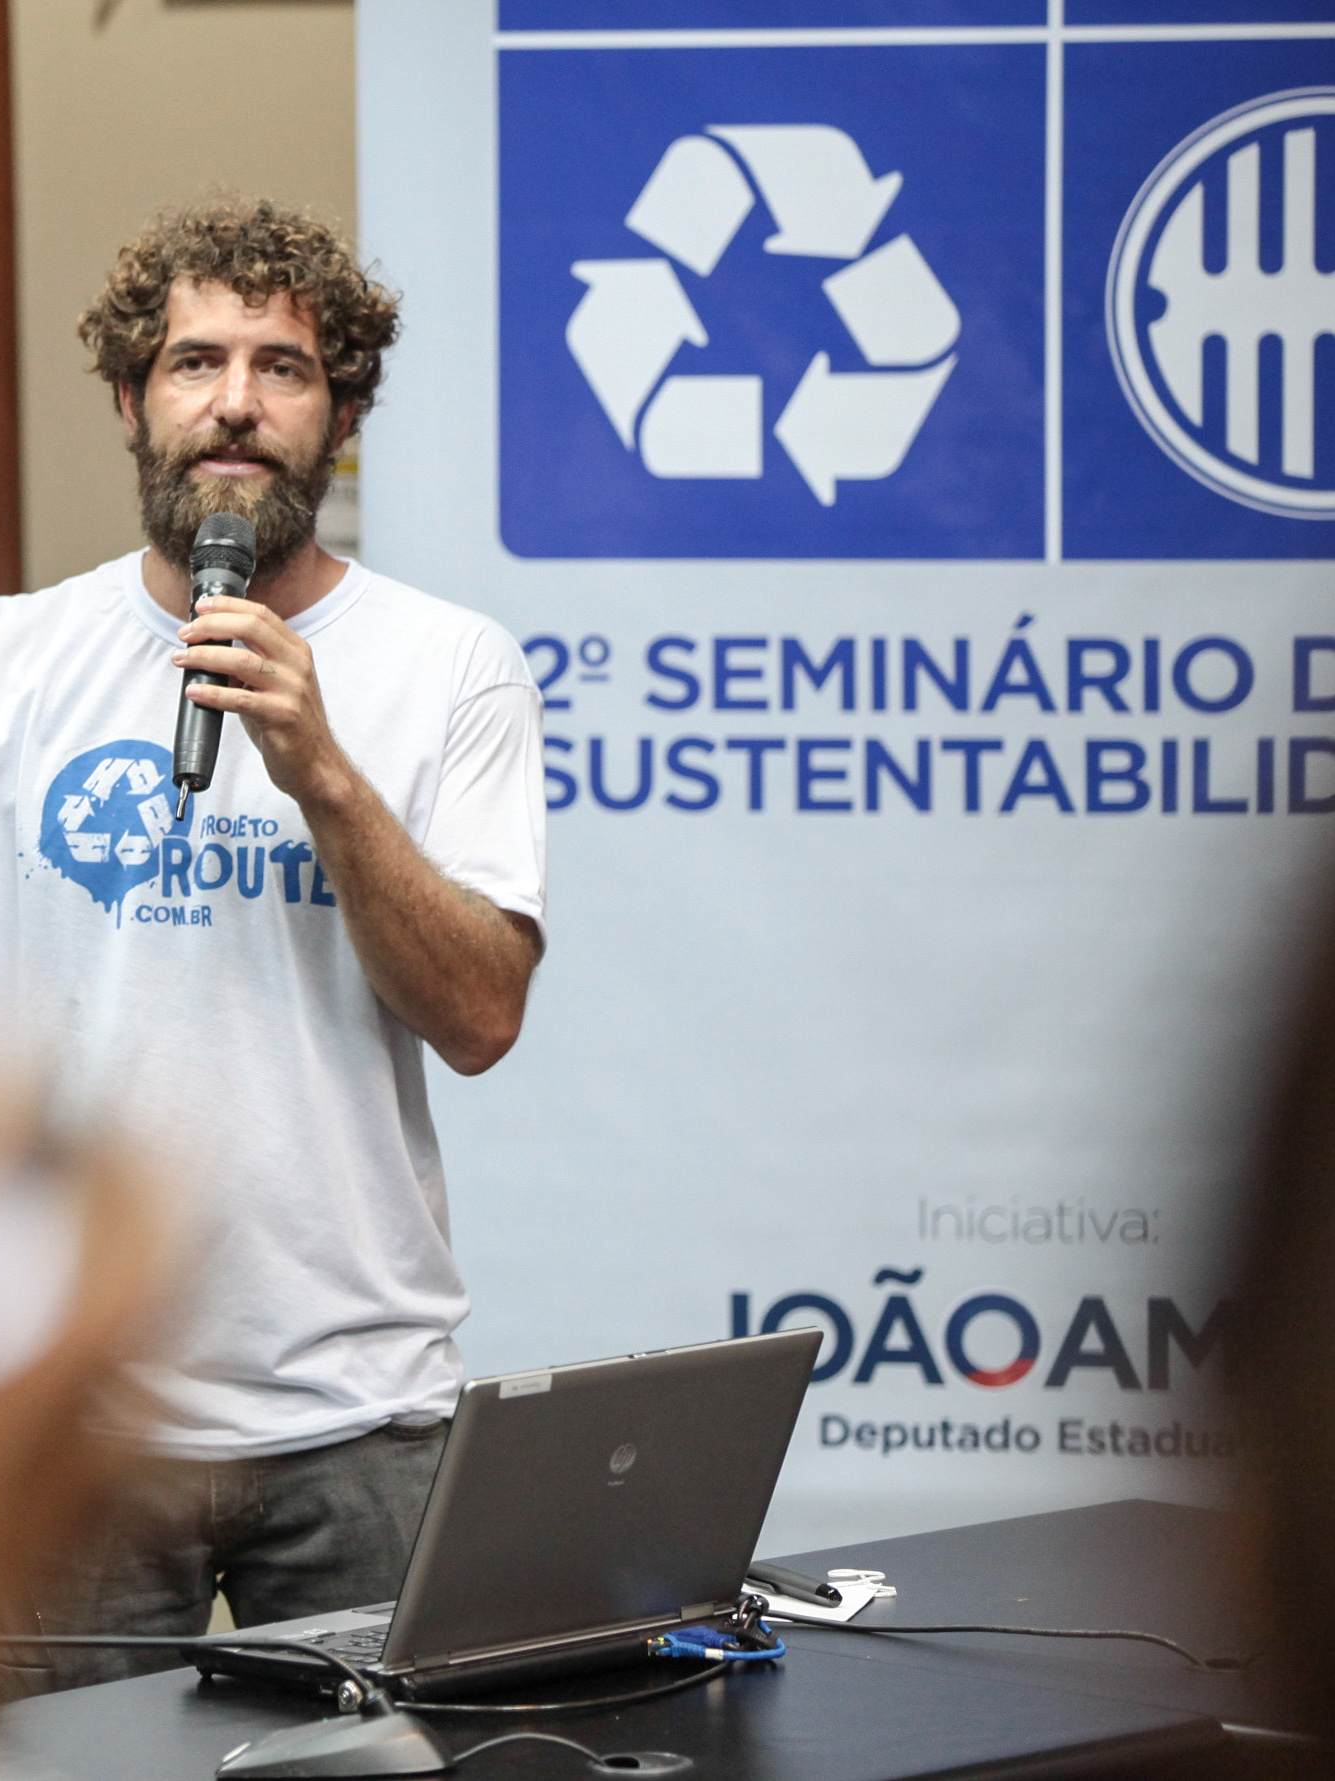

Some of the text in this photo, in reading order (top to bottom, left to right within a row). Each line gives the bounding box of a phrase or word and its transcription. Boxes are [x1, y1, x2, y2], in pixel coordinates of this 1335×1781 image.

[522, 634, 610, 711] 2º
[644, 612, 1256, 715] SEMINÁRIO
[543, 733, 1335, 816] SUSTENTABILID
[200, 814, 279, 841] PROJETO
[917, 1195, 1160, 1244] Iniciativa:
[820, 1414, 1042, 1457] Deputado
